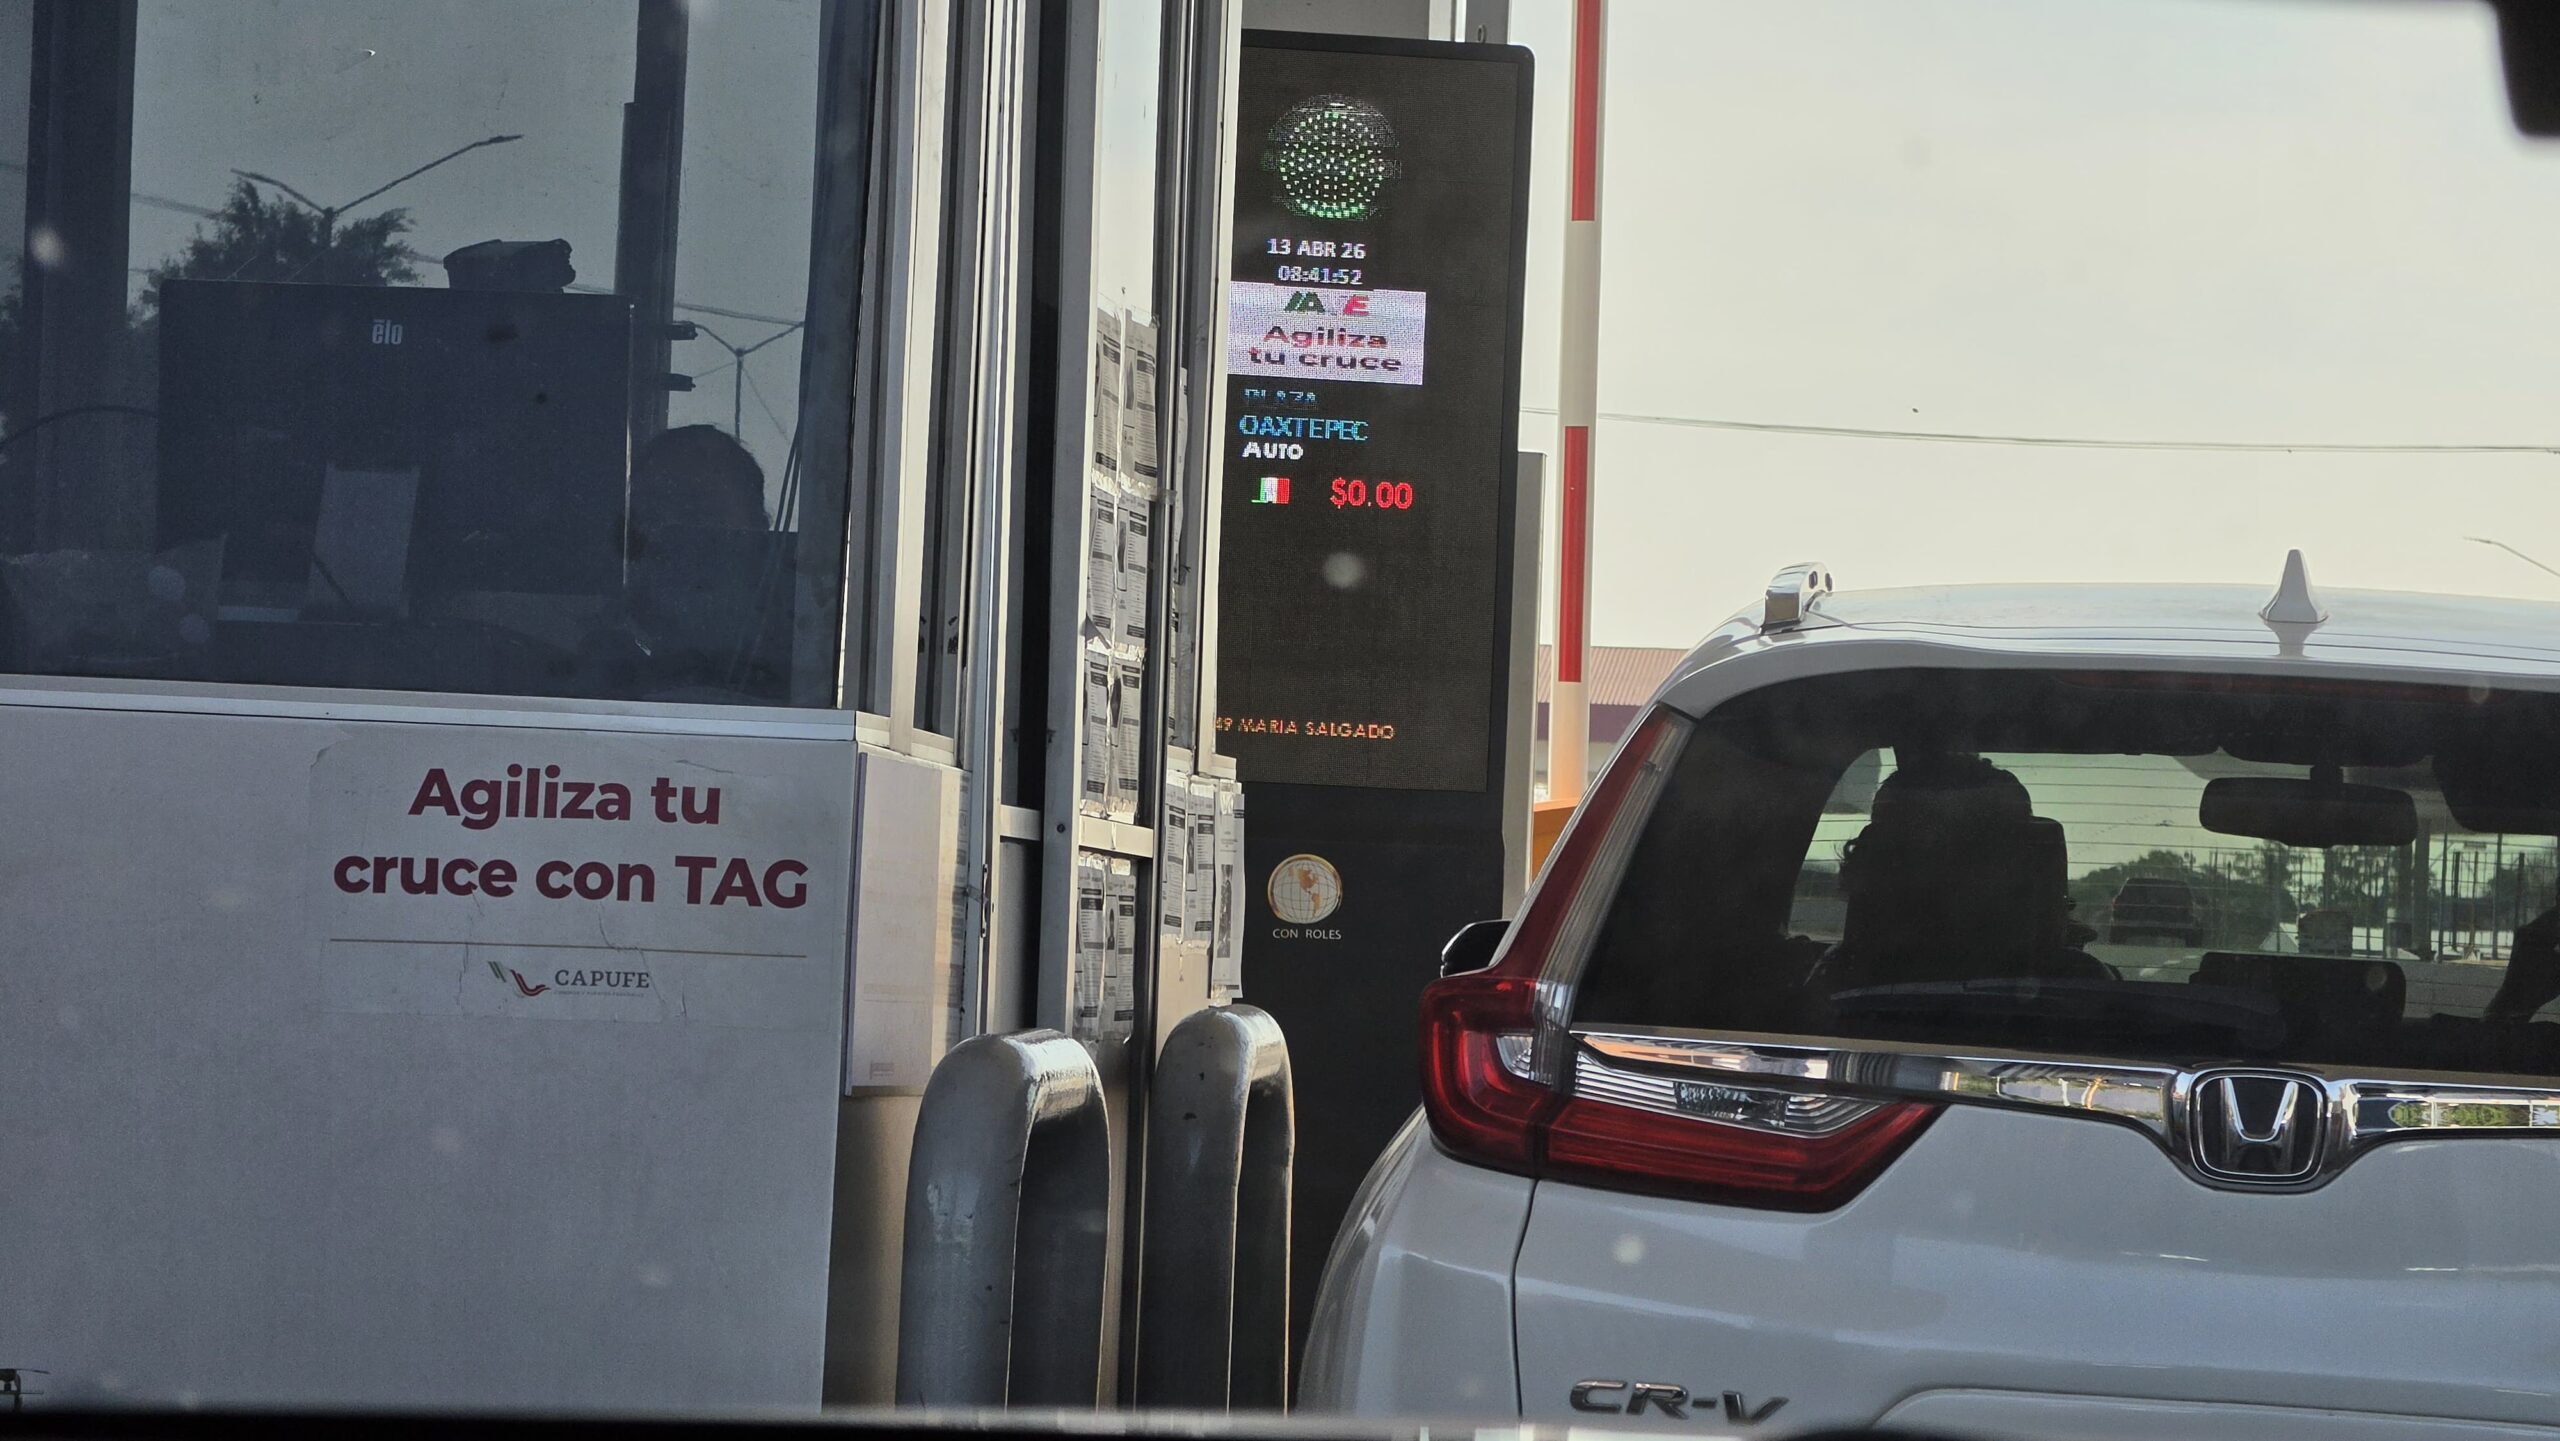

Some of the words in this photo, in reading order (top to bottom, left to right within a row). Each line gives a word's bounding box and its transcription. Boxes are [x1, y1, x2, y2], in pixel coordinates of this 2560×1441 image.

[1267, 238, 1291, 255] 13
[1297, 239, 1336, 258] ABR
[1340, 242, 1366, 260] 26
[1263, 326, 1388, 349] Agiliza
[1248, 347, 1286, 366] tu
[1298, 353, 1402, 371] cruce
[1238, 414, 1369, 441] OAXTEPEC
[1241, 441, 1304, 460] AUTO
[1330, 476, 1414, 510] $0.00
[1238, 718, 1298, 735] MARIA
[1305, 721, 1397, 740] SALGADO
[408, 763, 632, 830] Agiliza
[650, 777, 721, 825] tu
[333, 854, 517, 897] cruce
[535, 860, 656, 903] con
[674, 855, 809, 909] TAG
[1272, 928, 1299, 939] CON
[1305, 929, 1342, 940] ROLES
[555, 969, 649, 988] CAPUFE
[1569, 1380, 1790, 1426] CR-V
